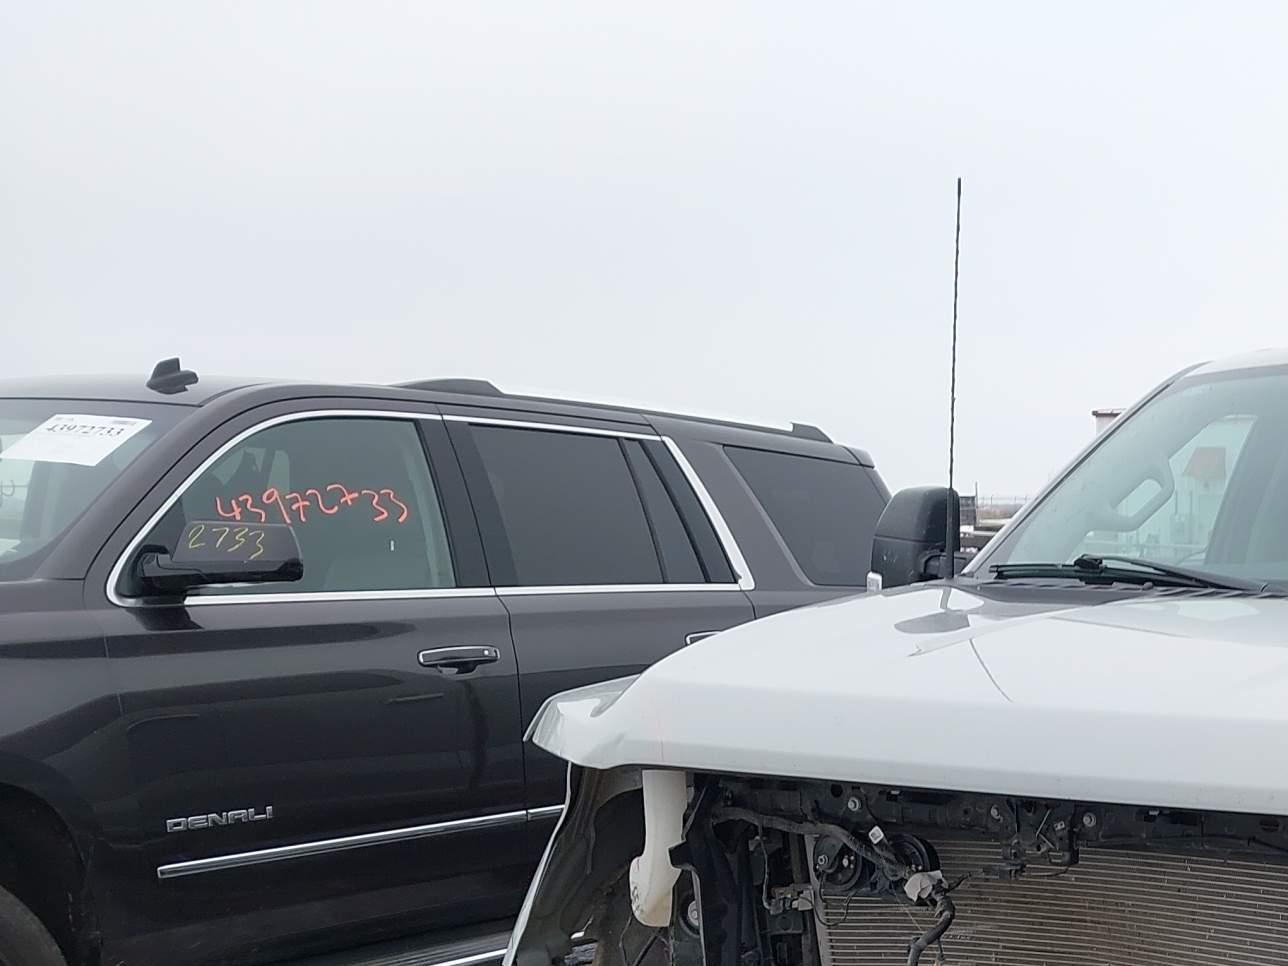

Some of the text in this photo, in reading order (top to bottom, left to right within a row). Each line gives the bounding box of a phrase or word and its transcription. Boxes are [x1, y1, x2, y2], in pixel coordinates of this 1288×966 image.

[216, 483, 408, 525] 43972733
[188, 524, 265, 560] 2733
[165, 805, 273, 833] DENALI
